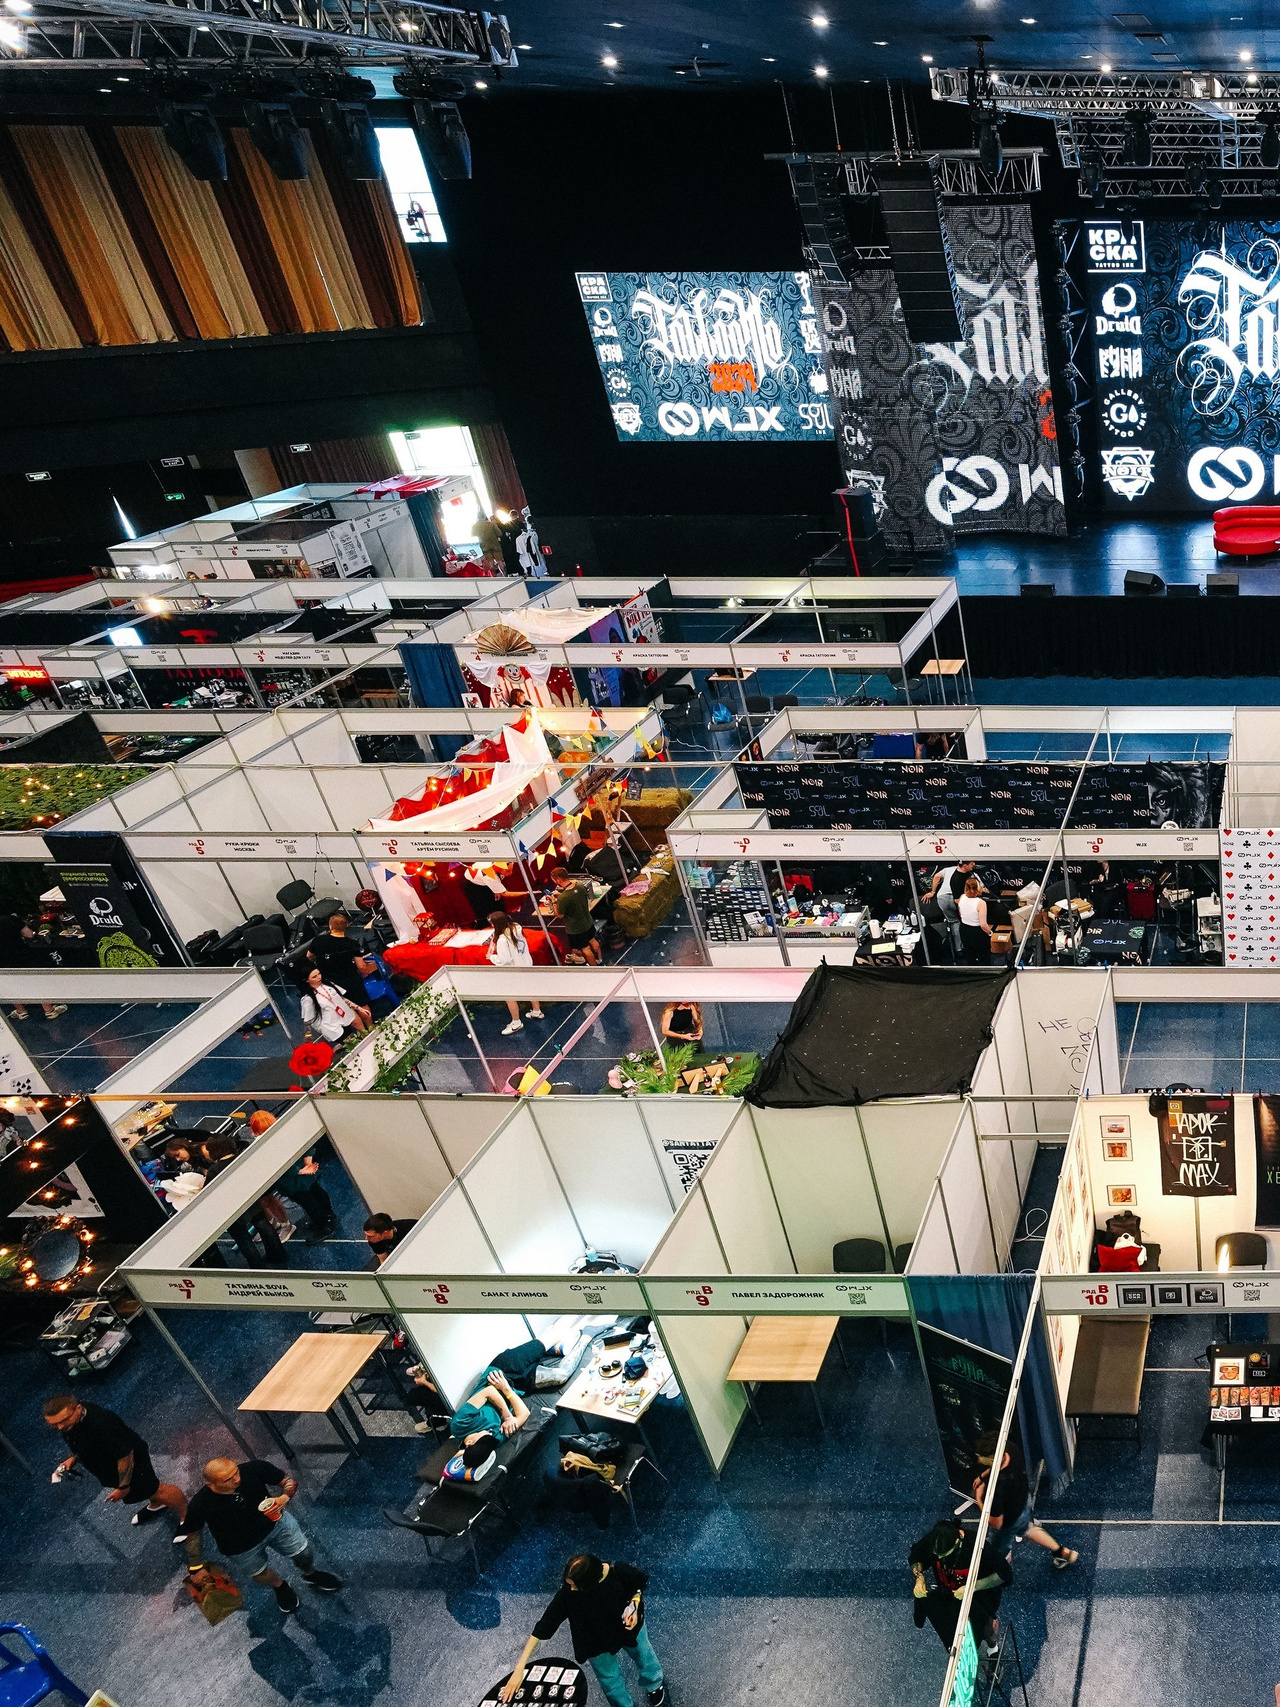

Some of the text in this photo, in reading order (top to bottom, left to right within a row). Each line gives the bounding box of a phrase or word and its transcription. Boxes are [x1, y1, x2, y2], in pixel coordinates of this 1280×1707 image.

[1089, 245, 1138, 260] СКА
[709, 362, 758, 393] 2024
[1104, 388, 1144, 406] GALLERY
[1102, 411, 1147, 437] TATTOO INK
[775, 764, 799, 774] NOIR
[901, 765, 924, 774] NOIR
[1026, 766, 1049, 775] NOIR
[801, 778, 824, 787] NOIR
[925, 778, 948, 787] NOIR
[1050, 779, 1072, 788] NOIR
[743, 792, 764, 802] NOIR
[866, 790, 888, 799] NOIR
[767, 807, 790, 817] NOIR
[891, 807, 912, 816] NOIR
[196, 847, 205, 855] 5
[389, 846, 397, 855] 6
[739, 845, 747, 853] 7
[935, 845, 943, 853] 8
[1092, 845, 1100, 853] 9
[1173, 1163, 1228, 1187] MAX
[182, 1279, 196, 1288] B
[228, 1289, 263, 1297] АНДРЕЙ
[437, 1284, 450, 1293] B
[701, 1285, 713, 1294] B
[1098, 1284, 1109, 1293] B
[179, 1288, 192, 1299] 7
[434, 1293, 449, 1304] 8
[695, 1295, 710, 1306] 9
[1085, 1294, 1108, 1305] 10
